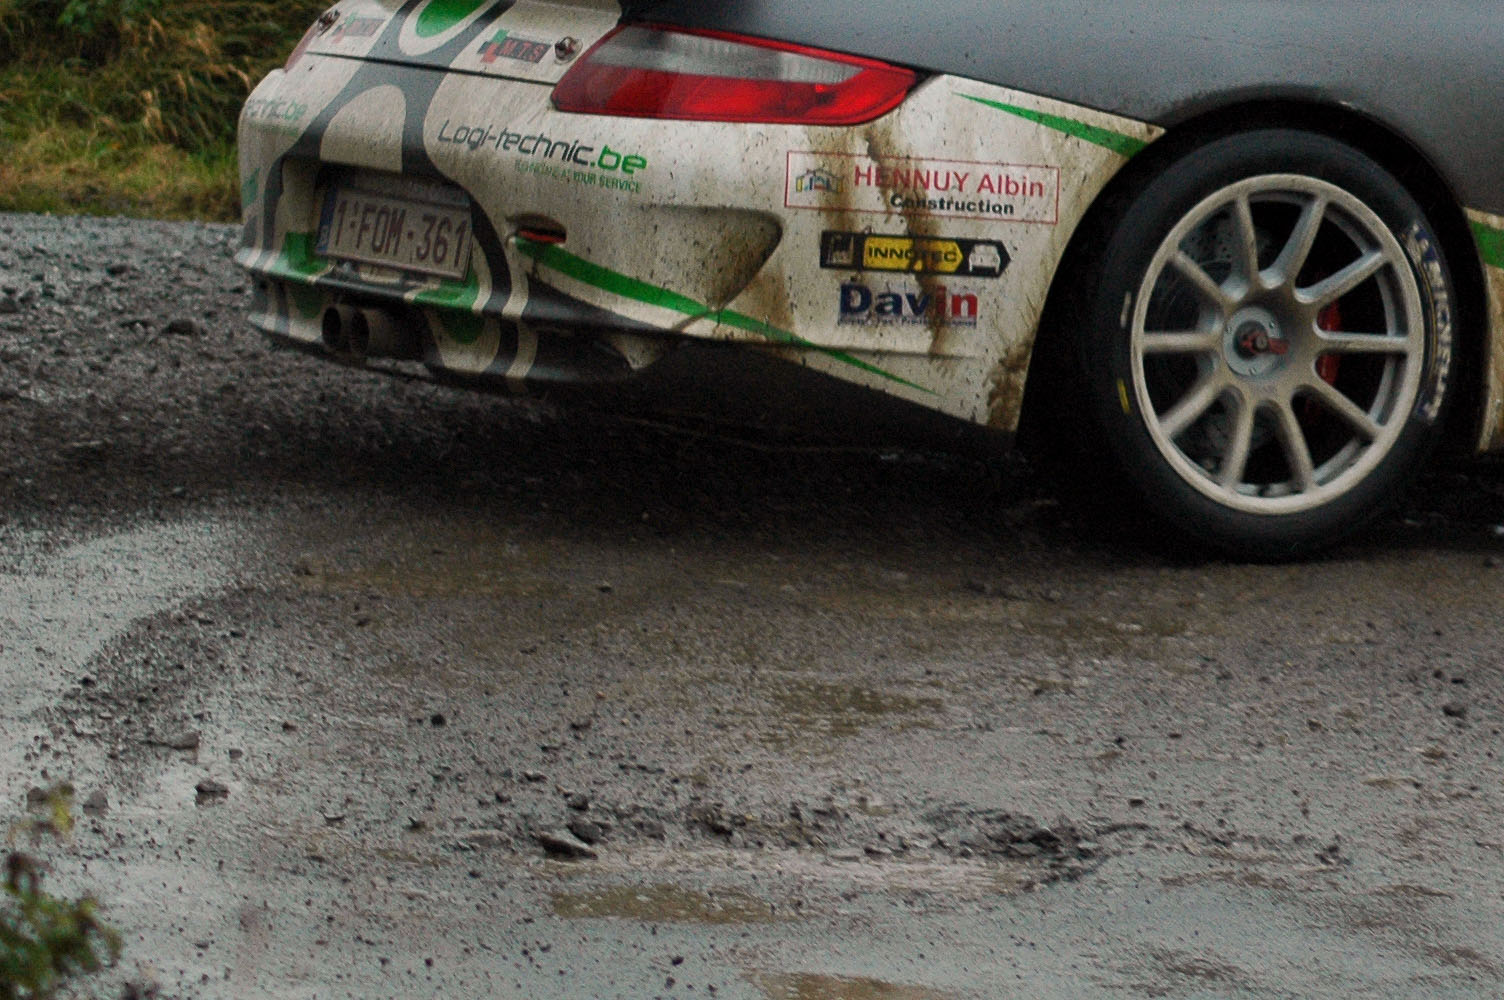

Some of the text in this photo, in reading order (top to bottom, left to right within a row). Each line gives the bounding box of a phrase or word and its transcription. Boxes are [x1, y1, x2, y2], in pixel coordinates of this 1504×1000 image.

[437, 119, 647, 174] Logi-technic.be
[854, 165, 1045, 197] HENNUY Albin
[891, 193, 1014, 216] Construction
[868, 247, 957, 262] INNOC
[839, 283, 979, 320] Davin
